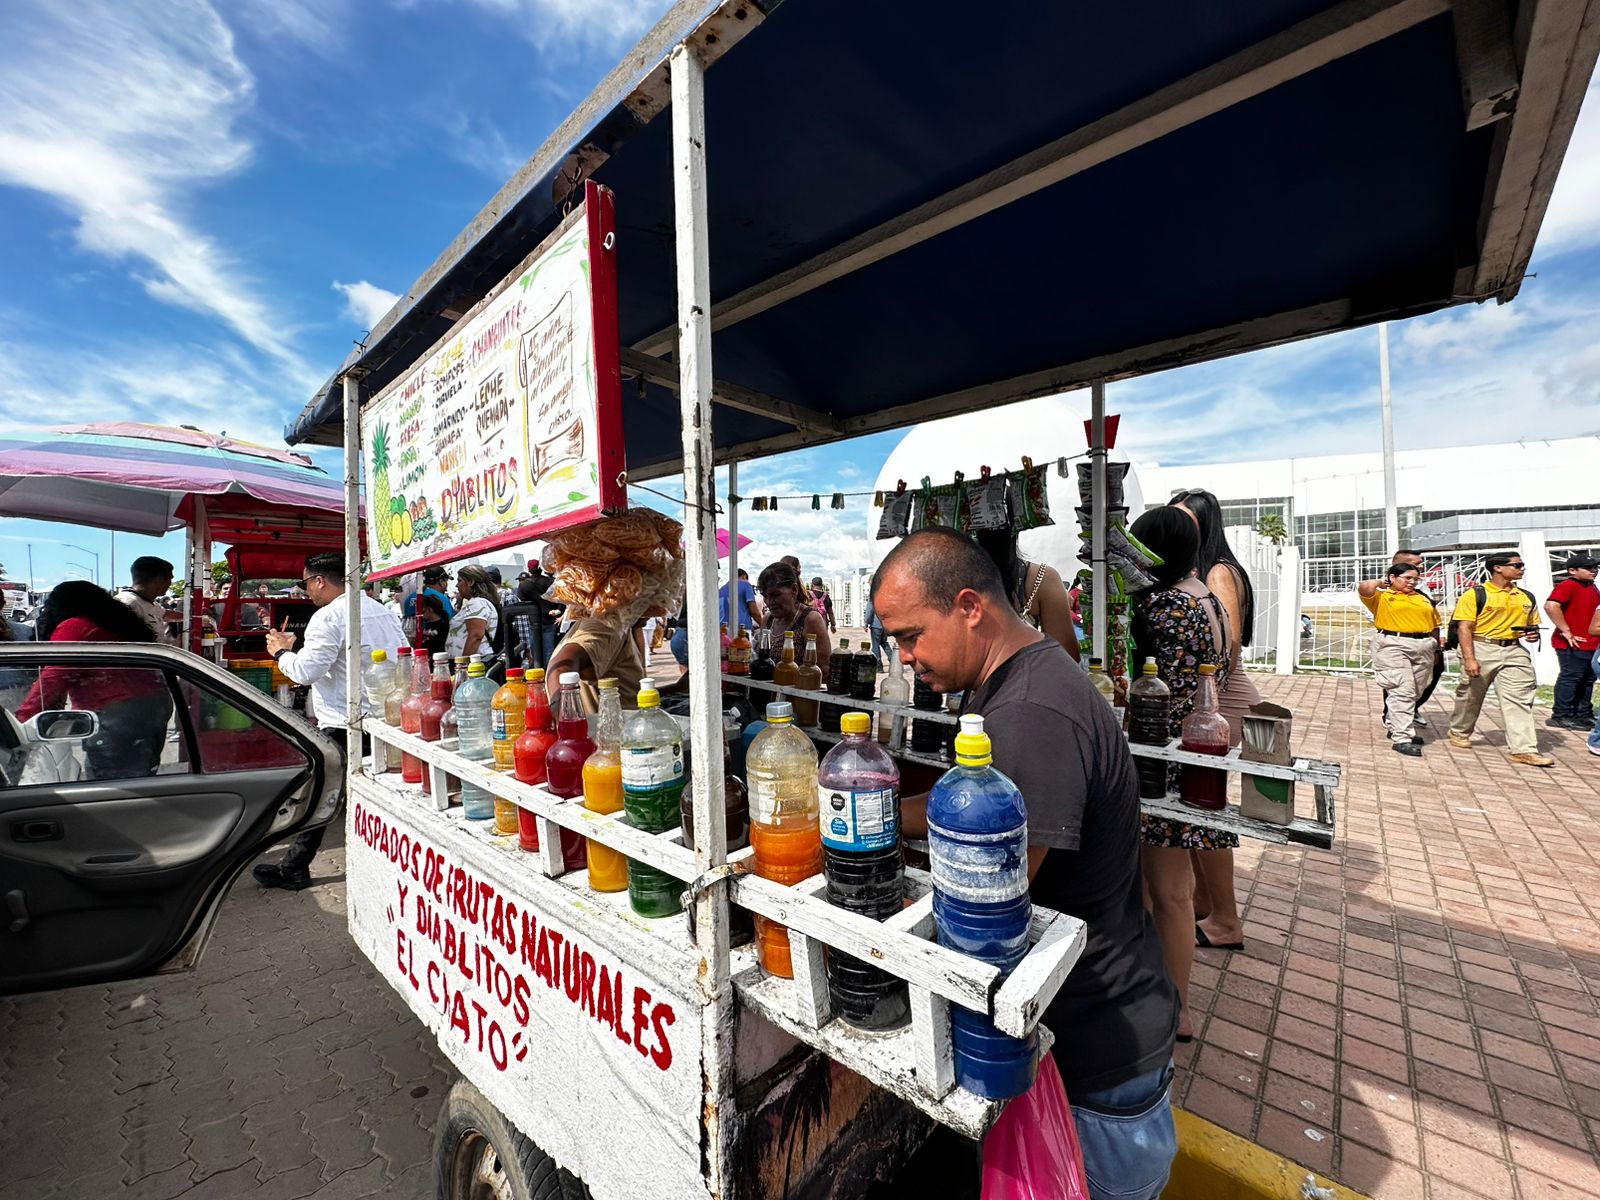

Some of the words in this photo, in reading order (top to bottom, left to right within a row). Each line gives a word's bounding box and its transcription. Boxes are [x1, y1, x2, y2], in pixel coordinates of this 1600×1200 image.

[354, 803, 421, 881] RASPADOS
[423, 847, 446, 902] DE
[446, 861, 518, 955] FRUTAS
[521, 910, 676, 1071] NATURALES
[397, 878, 408, 918] Y
